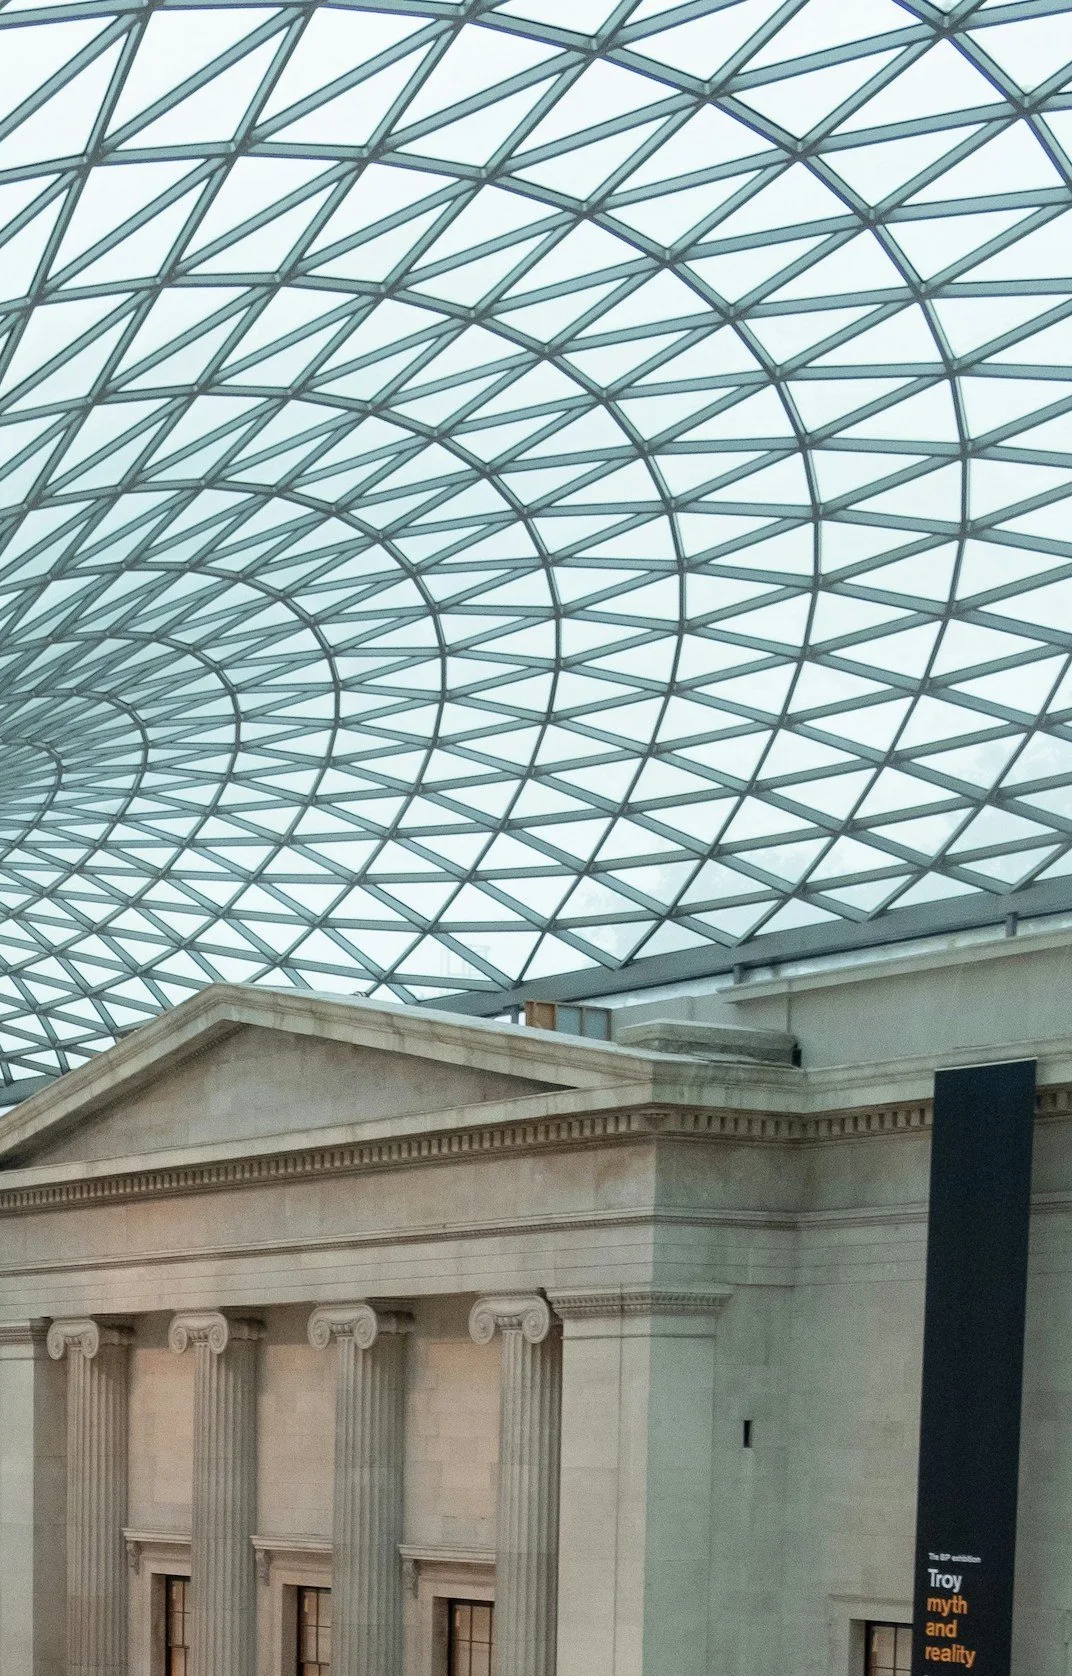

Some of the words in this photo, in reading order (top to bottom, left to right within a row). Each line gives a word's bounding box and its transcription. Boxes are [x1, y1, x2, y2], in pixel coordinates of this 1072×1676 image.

[928, 1568, 963, 1593] Troy
[927, 1594, 968, 1617] myth
[925, 1619, 958, 1638] and
[924, 1643, 977, 1669] reality
